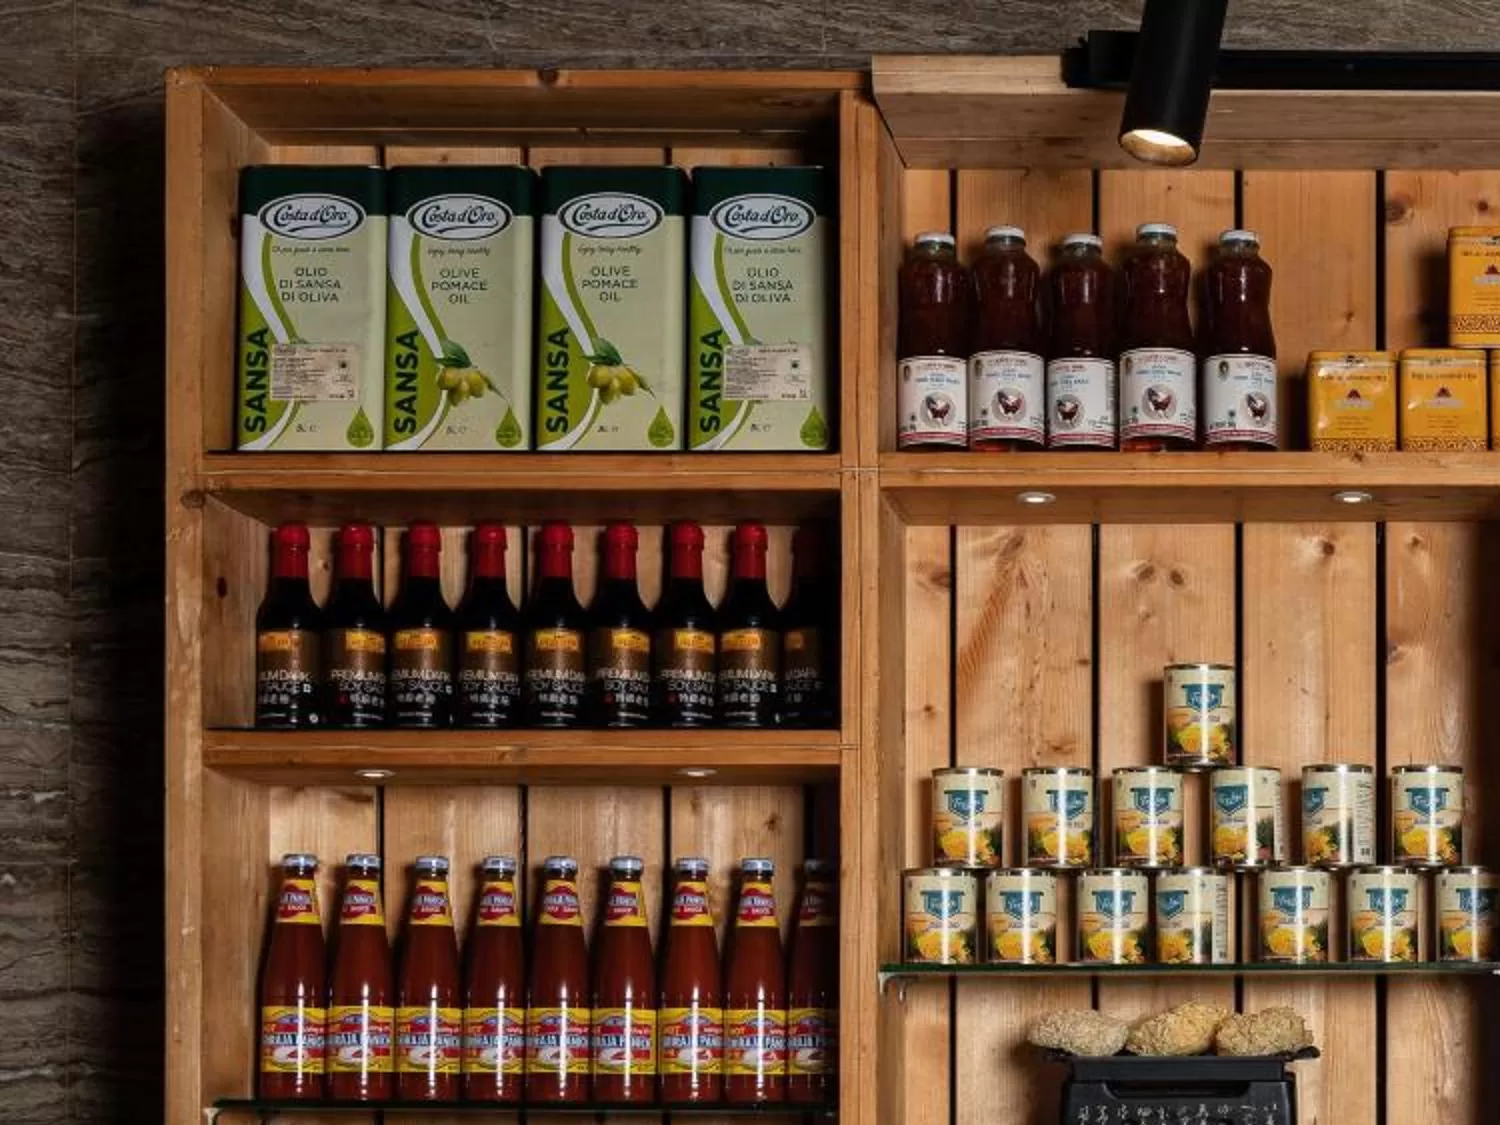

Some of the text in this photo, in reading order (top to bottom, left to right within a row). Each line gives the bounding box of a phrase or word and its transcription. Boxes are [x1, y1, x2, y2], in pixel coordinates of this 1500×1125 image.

[294, 267, 328, 277] OLIO
[439, 268, 480, 279] OLIVE
[590, 266, 631, 276] OLIVE
[746, 267, 779, 278] OLIO
[279, 279, 341, 289] DI SANSA
[431, 281, 488, 291] POMACE
[581, 279, 638, 289] POMACE
[732, 280, 794, 290] DI SANSA
[281, 292, 339, 302] DI OLIVA
[447, 294, 470, 304] OIL
[599, 291, 620, 302] OIL
[735, 293, 791, 303] DI OLIVA
[245, 328, 269, 432] SANSA
[394, 329, 419, 434] SANSA
[545, 327, 570, 433] SANSA
[700, 328, 723, 432] SANSA
